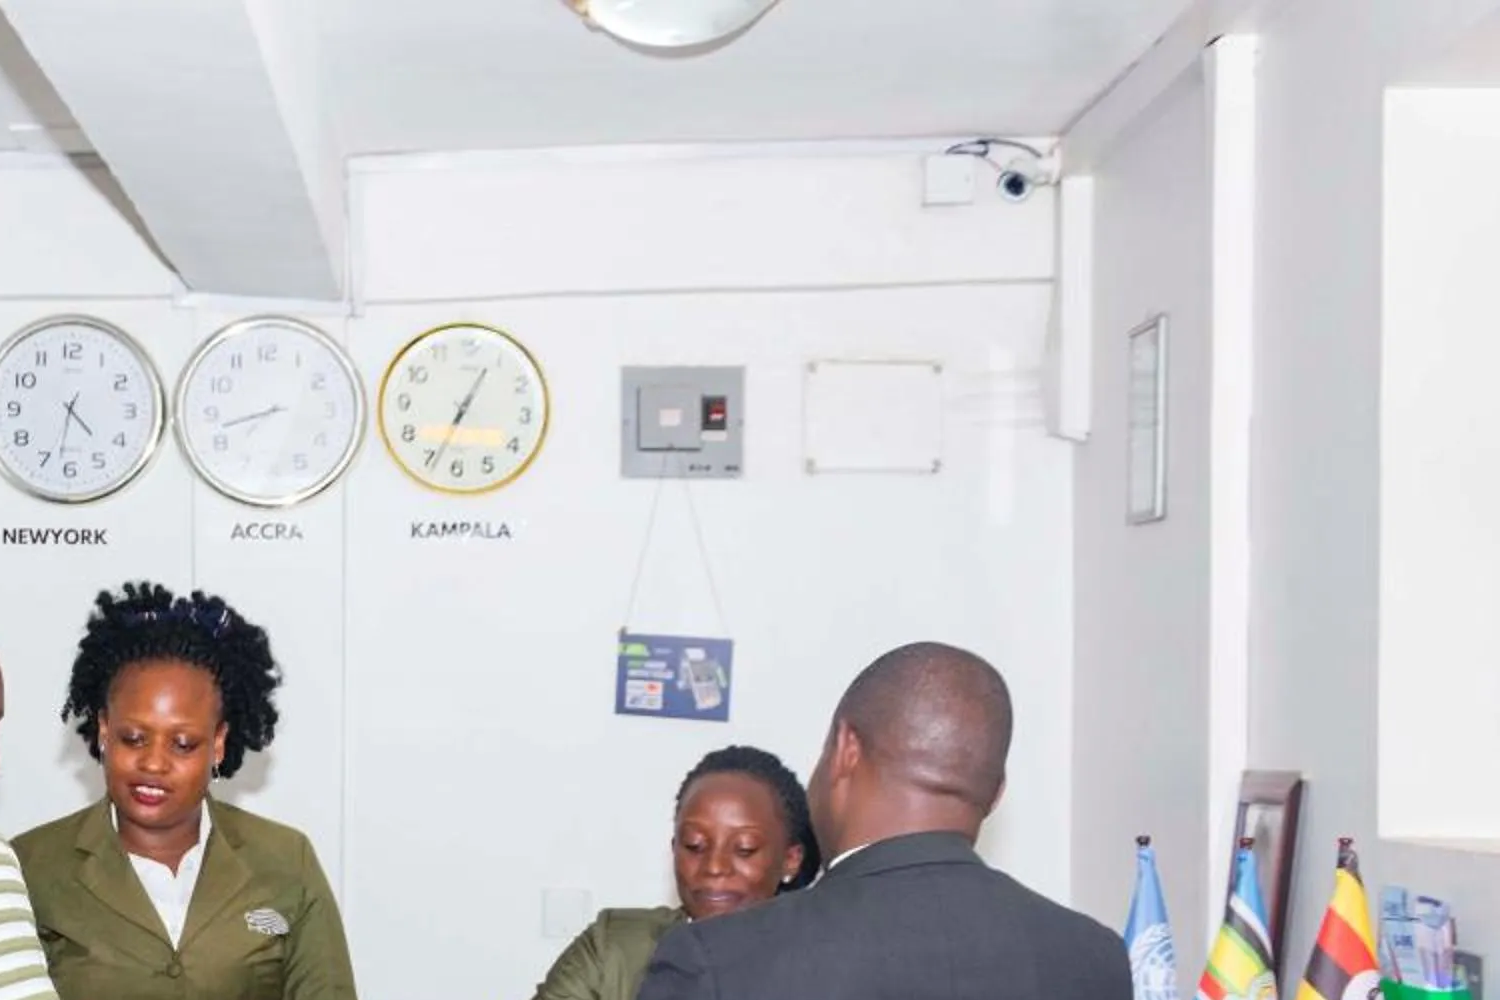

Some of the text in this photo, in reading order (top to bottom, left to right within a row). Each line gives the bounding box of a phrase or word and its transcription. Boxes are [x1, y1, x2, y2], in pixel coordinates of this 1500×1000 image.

[35, 350, 47, 367] 11
[63, 342, 83, 360] 12
[99, 351, 105, 368] 1
[257, 343, 278, 362] 12
[230, 353, 243, 370] 11
[15, 371, 37, 389] 10
[113, 373, 128, 391] 2
[310, 372, 326, 390] 2
[409, 365, 429, 384] 10
[211, 375, 233, 394] 10
[514, 374, 529, 394] 2
[6, 400, 21, 418] 9
[122, 403, 137, 420] 3
[397, 393, 412, 412] 9
[203, 405, 219, 423] 9
[518, 406, 532, 425] 3
[13, 429, 29, 447] 8
[112, 431, 127, 448] 4
[213, 434, 229, 451] 8
[401, 424, 417, 443] 8
[506, 436, 520, 454] 4
[37, 450, 51, 468] 7
[91, 452, 106, 470] 5
[292, 452, 308, 470] 5
[423, 447, 436, 467] 7
[480, 455, 495, 475] 5
[63, 461, 78, 479] 6
[450, 459, 464, 478] 6
[3, 528, 108, 545] NEWYORK
[230, 523, 304, 540] ACCRA
[410, 522, 511, 539] KAMPALA
